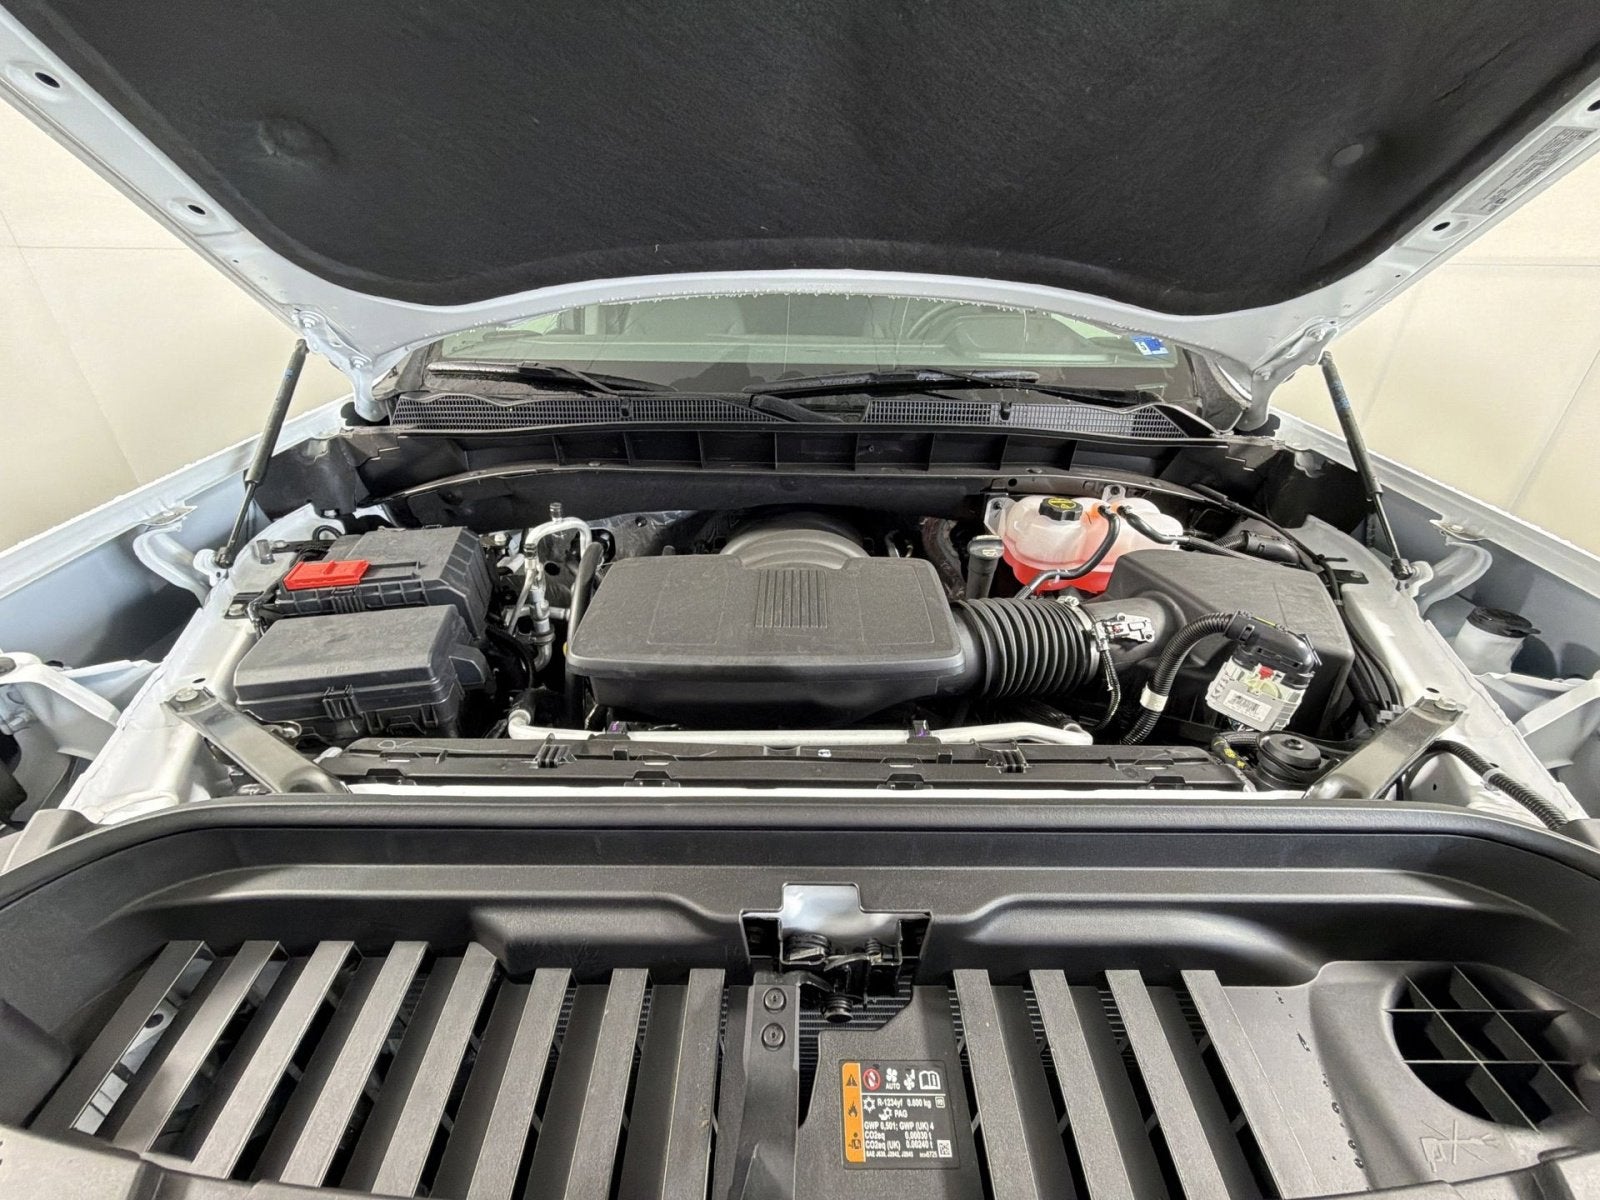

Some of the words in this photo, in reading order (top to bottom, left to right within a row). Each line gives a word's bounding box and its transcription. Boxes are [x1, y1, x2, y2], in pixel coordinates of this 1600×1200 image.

[923, 1098, 932, 1109] kg
[894, 1109, 908, 1118] PAG
[864, 1121, 879, 1130] GWP
[899, 1121, 914, 1130] GWP
[915, 1121, 929, 1132] (UK)
[930, 1122, 934, 1130] 4
[864, 1131, 885, 1141] CO2eq
[865, 1140, 886, 1151] CO2eq
[887, 1140, 901, 1151] (UK)
